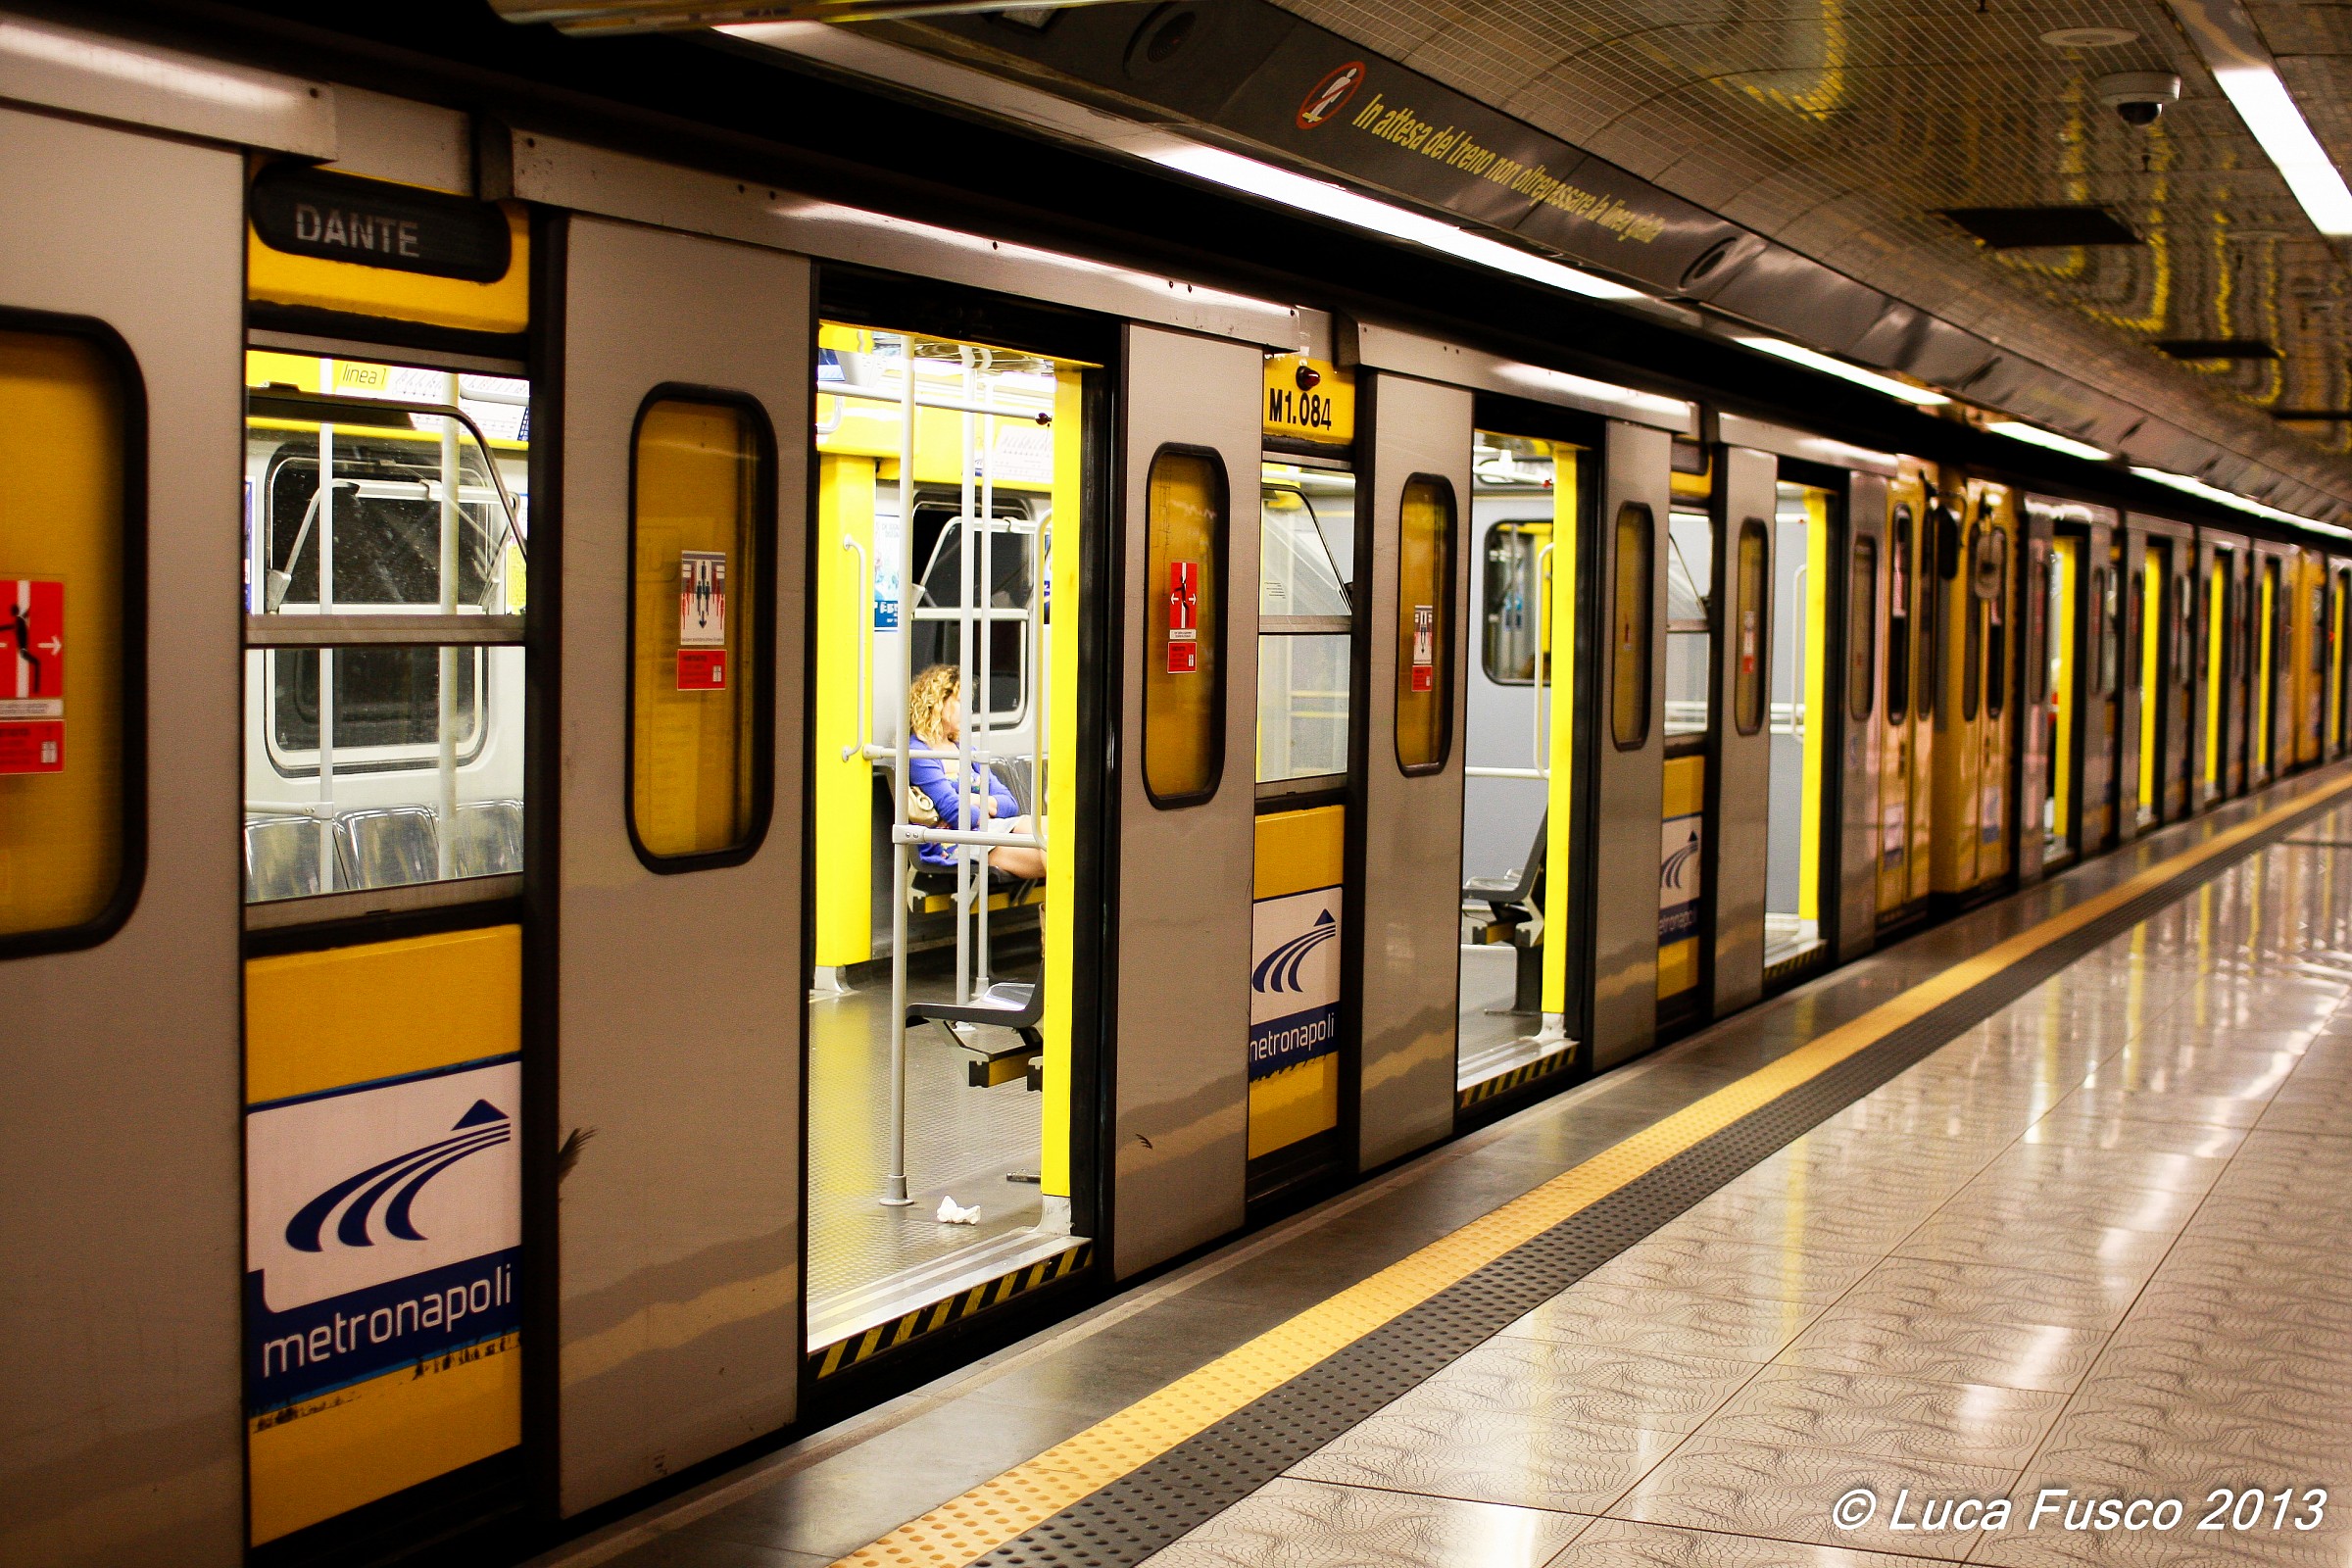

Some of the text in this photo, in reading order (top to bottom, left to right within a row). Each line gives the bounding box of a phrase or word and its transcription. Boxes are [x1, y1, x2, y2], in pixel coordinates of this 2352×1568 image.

[1352, 93, 1384, 129] In
[1372, 108, 1434, 150] attesa
[1421, 125, 1466, 160] del
[1446, 135, 1496, 175] treno
[1484, 157, 1523, 185] non
[1510, 165, 1596, 216] oltrepassare
[1584, 194, 1611, 221] la
[296, 203, 419, 258] DANTE
[343, 364, 377, 384] linea
[1269, 388, 1331, 431] M1.084
[264, 1263, 512, 1378] metronapoli
